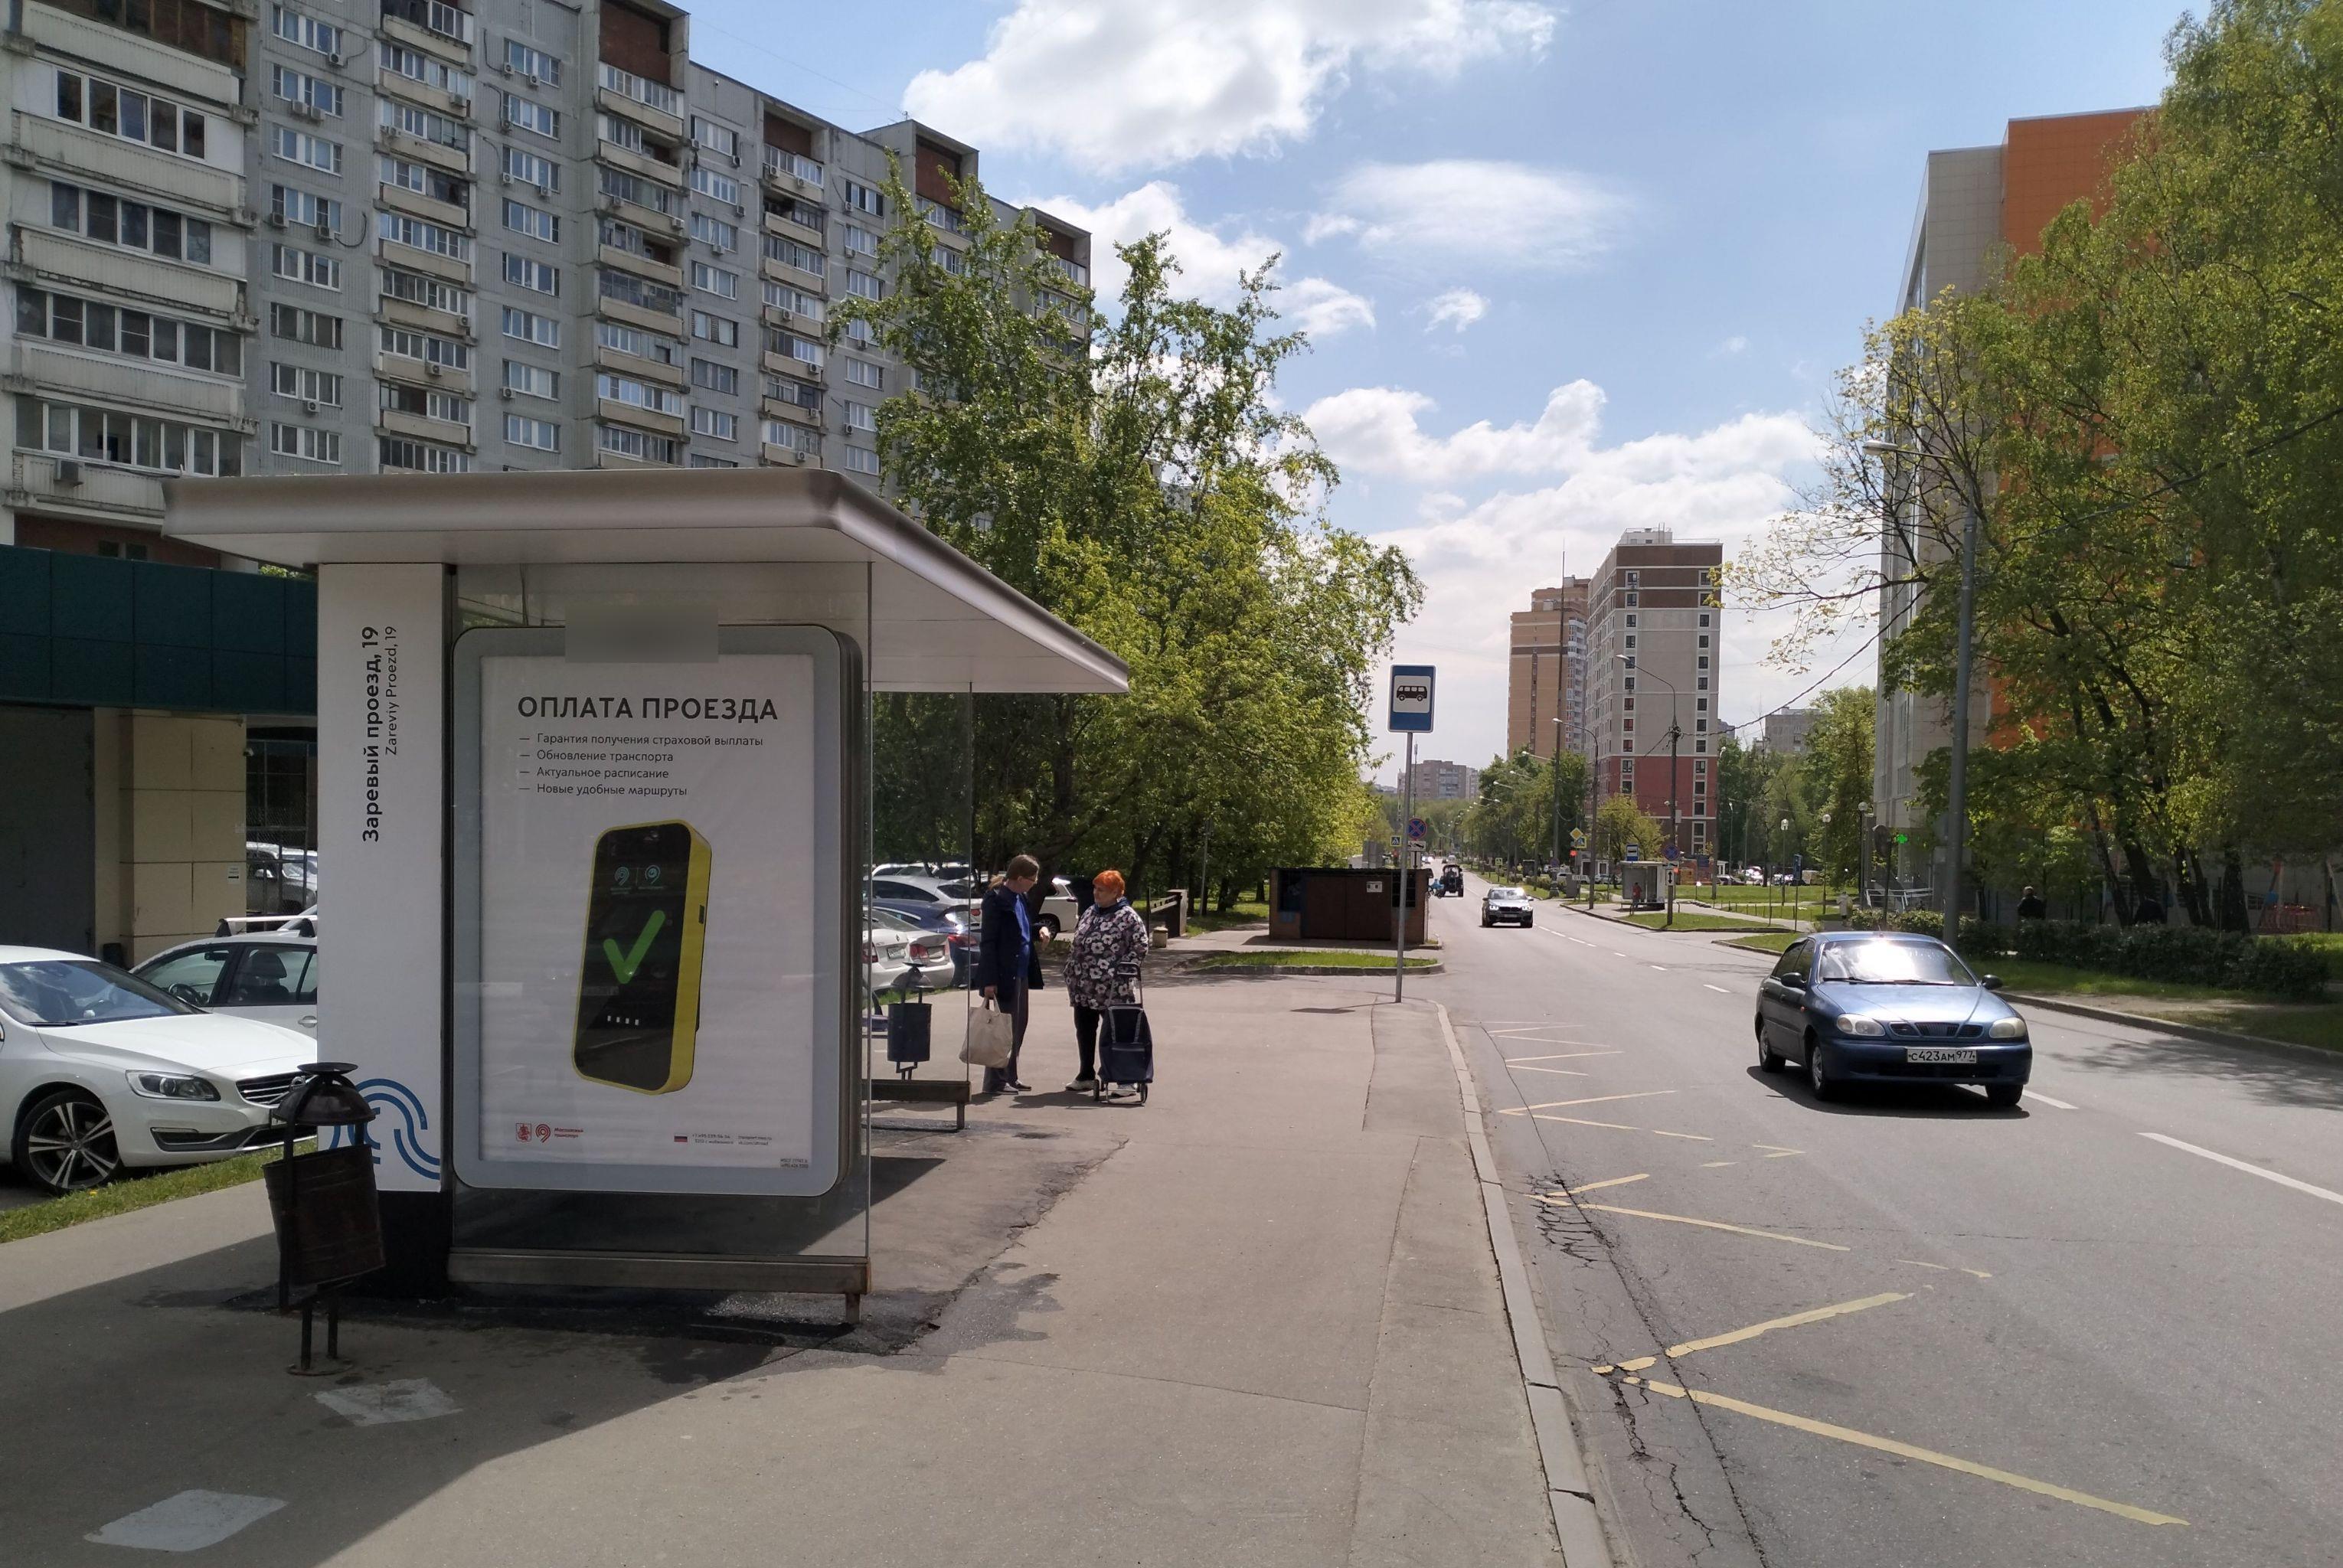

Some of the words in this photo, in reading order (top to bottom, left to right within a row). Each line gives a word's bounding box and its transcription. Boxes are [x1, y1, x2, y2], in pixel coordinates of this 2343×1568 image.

[361, 626, 379, 648] 19
[385, 626, 397, 641] 19
[385, 642, 397, 697] Proezd,
[366, 654, 384, 738] проезд,
[518, 696, 634, 719] ОПЛАТА
[642, 697, 778, 724] ПРОЕЗДА
[385, 701, 400, 756] Zareviy
[537, 733, 588, 746] Гарантия
[591, 736, 649, 746] получения
[652, 735, 711, 747] страховой
[714, 737, 763, 746] выплаты
[537, 749, 606, 761] Обновление
[609, 753, 674, 764] транспорта
[536, 766, 601, 779] Актуальное
[604, 769, 669, 780] расписание
[362, 745, 384, 843] Заревый
[537, 783, 574, 794] Новые
[577, 783, 626, 796] удобные
[628, 787, 688, 798] маршруты
[1956, 1050, 1973, 1060] 977
